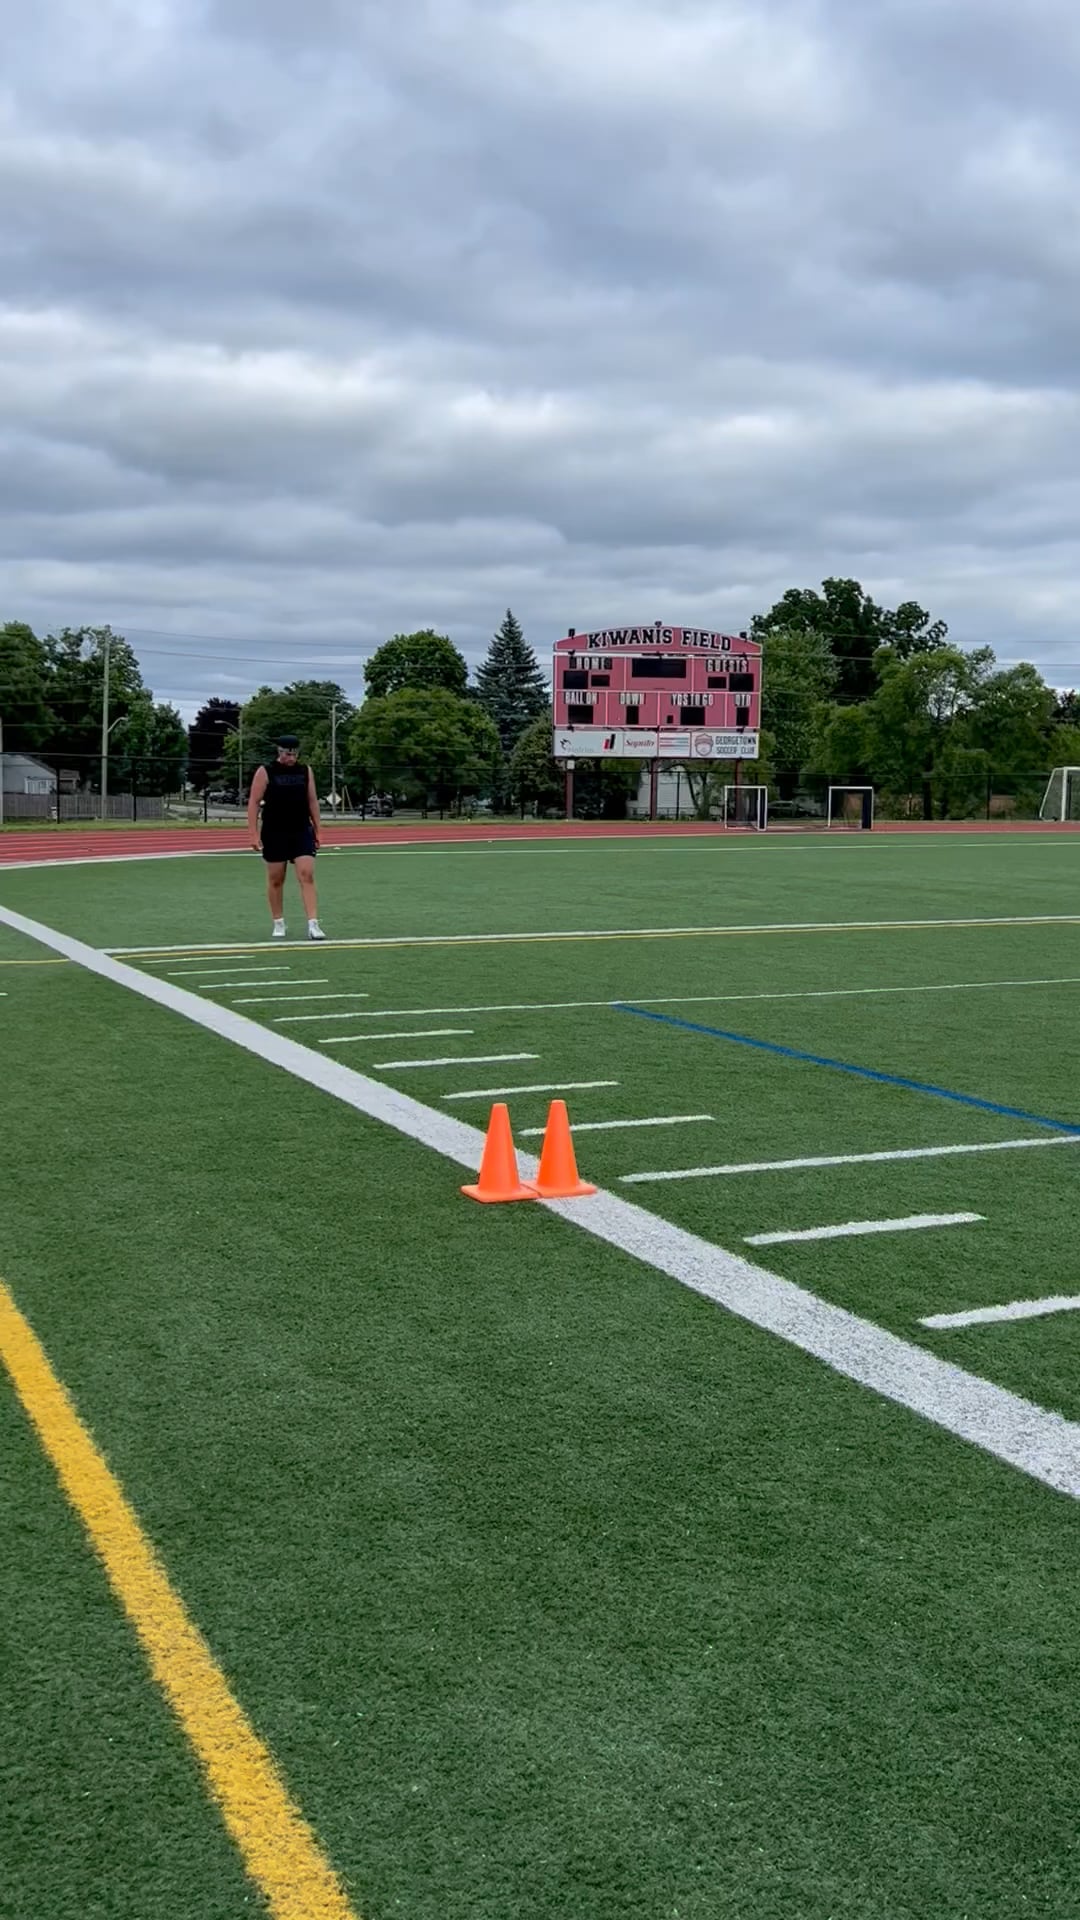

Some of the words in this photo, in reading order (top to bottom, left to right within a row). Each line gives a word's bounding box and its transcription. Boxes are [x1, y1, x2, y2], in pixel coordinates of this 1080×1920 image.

[588, 629, 673, 649] KIWANIS
[682, 630, 731, 651] FIELD
[576, 656, 606, 670] HOME
[707, 659, 748, 672] GUESTS
[620, 692, 645, 705] DOWN
[715, 735, 757, 745] GEORGETOWN
[716, 746, 737, 755] SOCCER
[740, 746, 755, 755] CLUB
